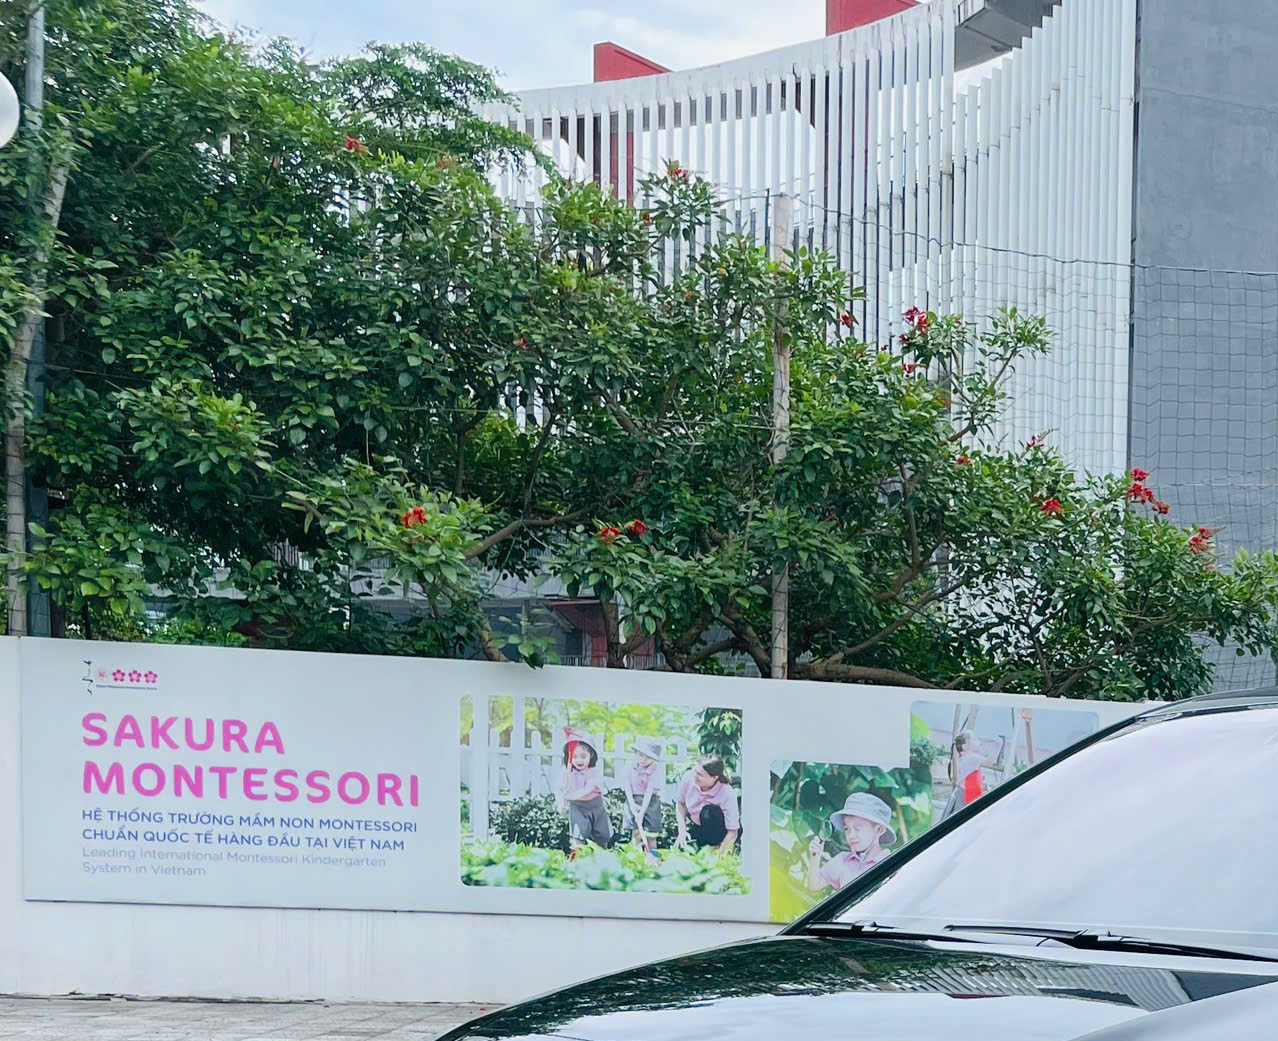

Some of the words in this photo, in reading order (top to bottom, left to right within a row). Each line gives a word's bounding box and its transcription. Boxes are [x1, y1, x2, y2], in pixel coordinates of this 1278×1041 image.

[81, 712, 285, 755] SAKURA
[82, 760, 419, 808] MONTESSORI
[82, 808, 103, 824] HỆ
[107, 807, 164, 824] THỐNG
[168, 811, 235, 827] TRƯỜNG
[280, 816, 315, 829] NON
[319, 818, 418, 833] MONTESSORI
[82, 825, 139, 842] CHUẨN
[143, 828, 191, 844] QUỐC
[195, 829, 214, 845] TẾ
[218, 831, 263, 847] HÀNG
[332, 835, 367, 852] VIỆT
[370, 839, 405, 851] NAM
[82, 847, 136, 861] Leading
[140, 848, 224, 862] International
[226, 851, 299, 865] Montessori
[302, 854, 388, 868] Kindergarten
[82, 861, 132, 875] System
[135, 863, 148, 874] in
[151, 864, 207, 877] Vietnam
